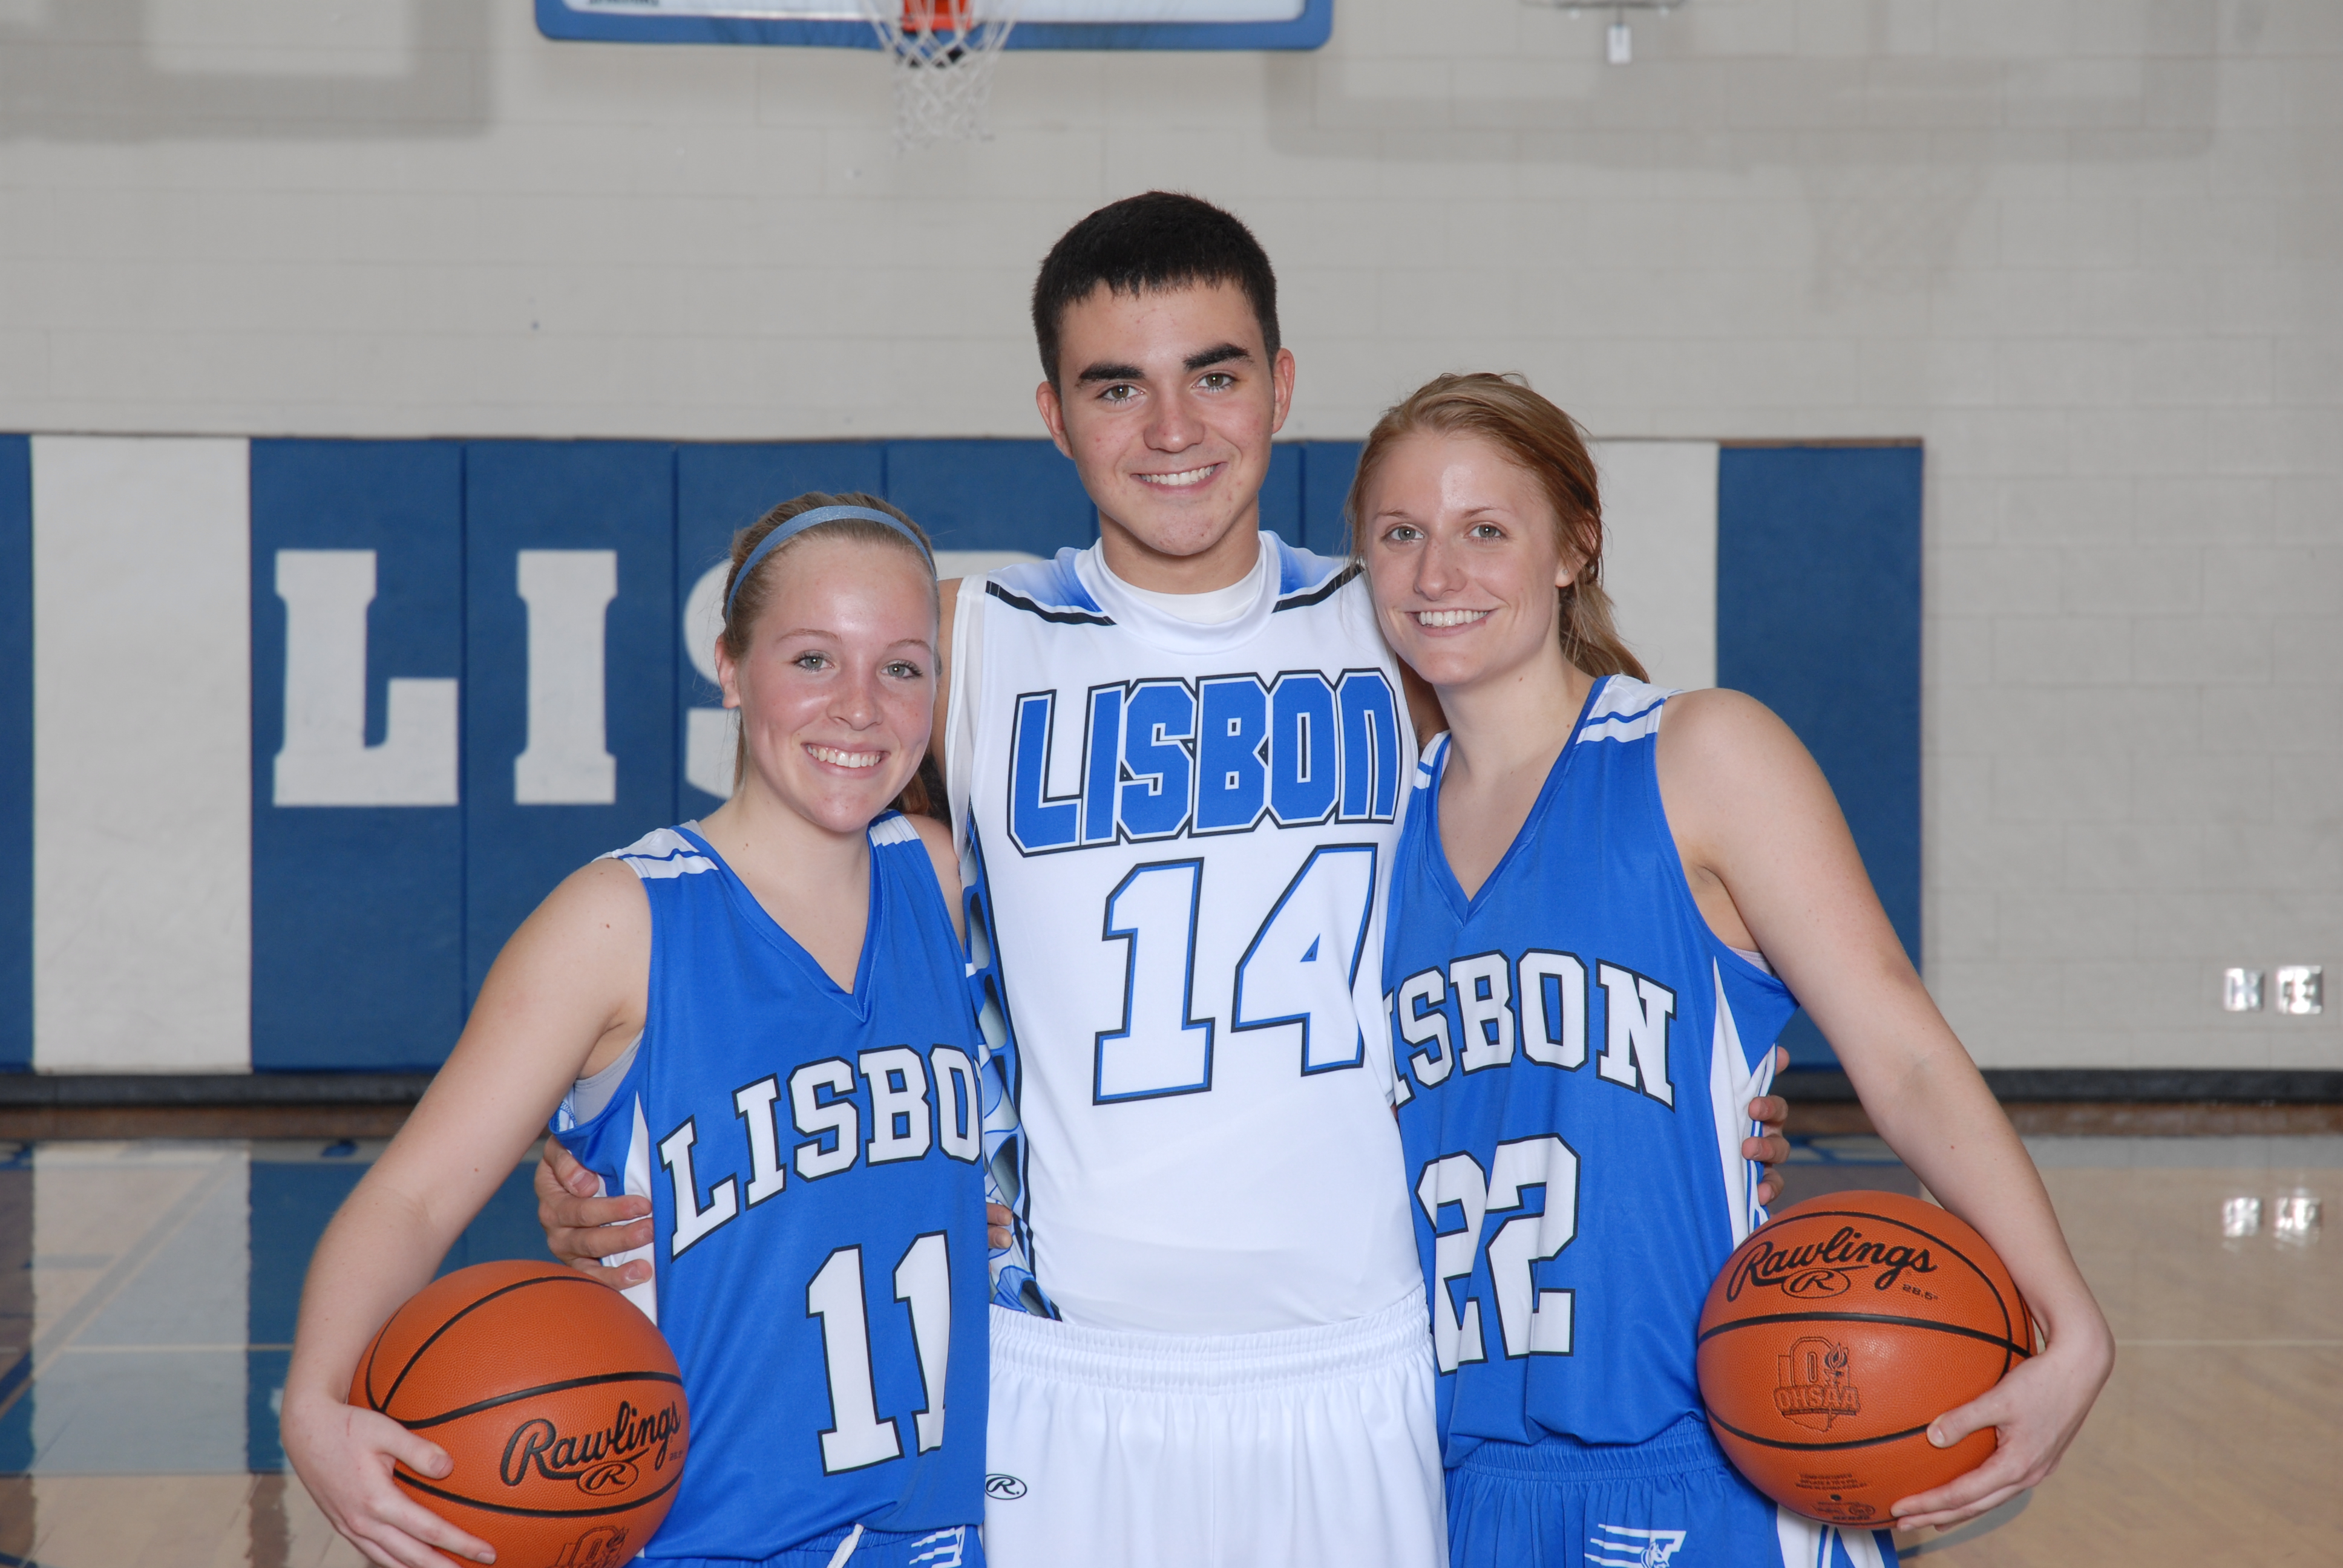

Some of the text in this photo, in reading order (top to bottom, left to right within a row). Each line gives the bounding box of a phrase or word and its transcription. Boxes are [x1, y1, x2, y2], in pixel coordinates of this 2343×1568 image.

[1007, 667, 1403, 858] LISBON
[1093, 843, 1378, 1106] 14
[656, 1044, 985, 1263] LISBO
[1414, 1132, 1581, 1377] 22
[806, 1229, 951, 1477] 11
[1726, 1226, 1938, 1302] Rawlings
[500, 1400, 681, 1486] Rawlings
